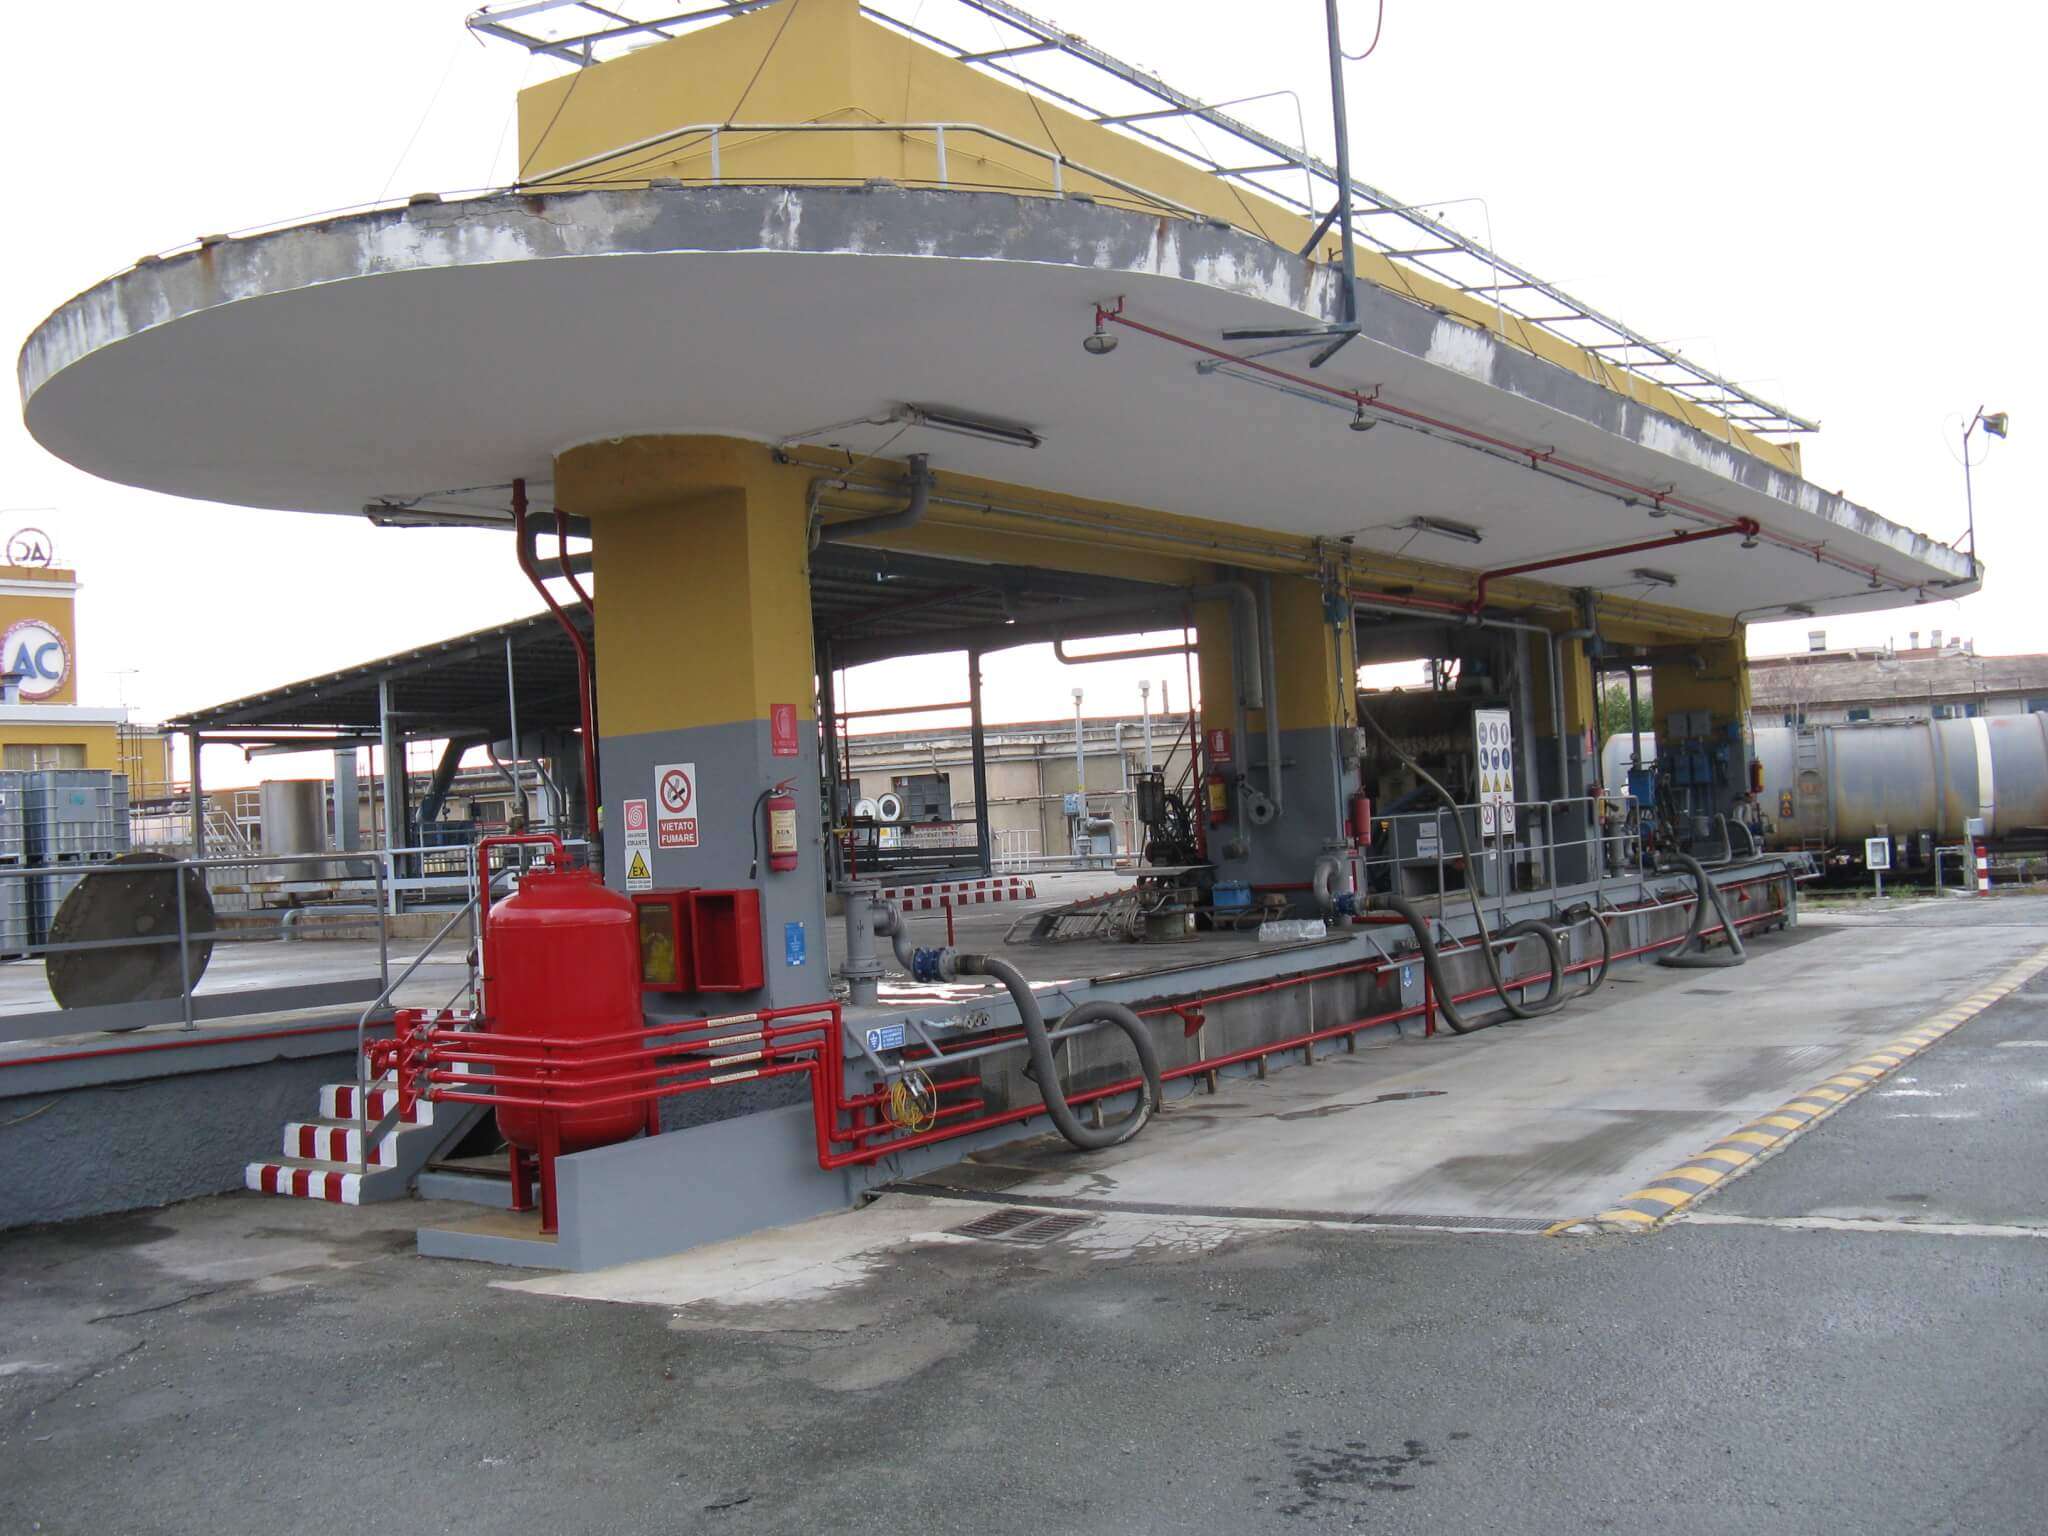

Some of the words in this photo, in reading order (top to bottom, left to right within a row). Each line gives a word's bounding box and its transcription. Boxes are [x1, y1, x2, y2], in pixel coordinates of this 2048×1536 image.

[12, 642, 59, 680] AC
[661, 822, 693, 832] VIETATO
[661, 833, 695, 844] FUMARE
[632, 866, 645, 877] EX
